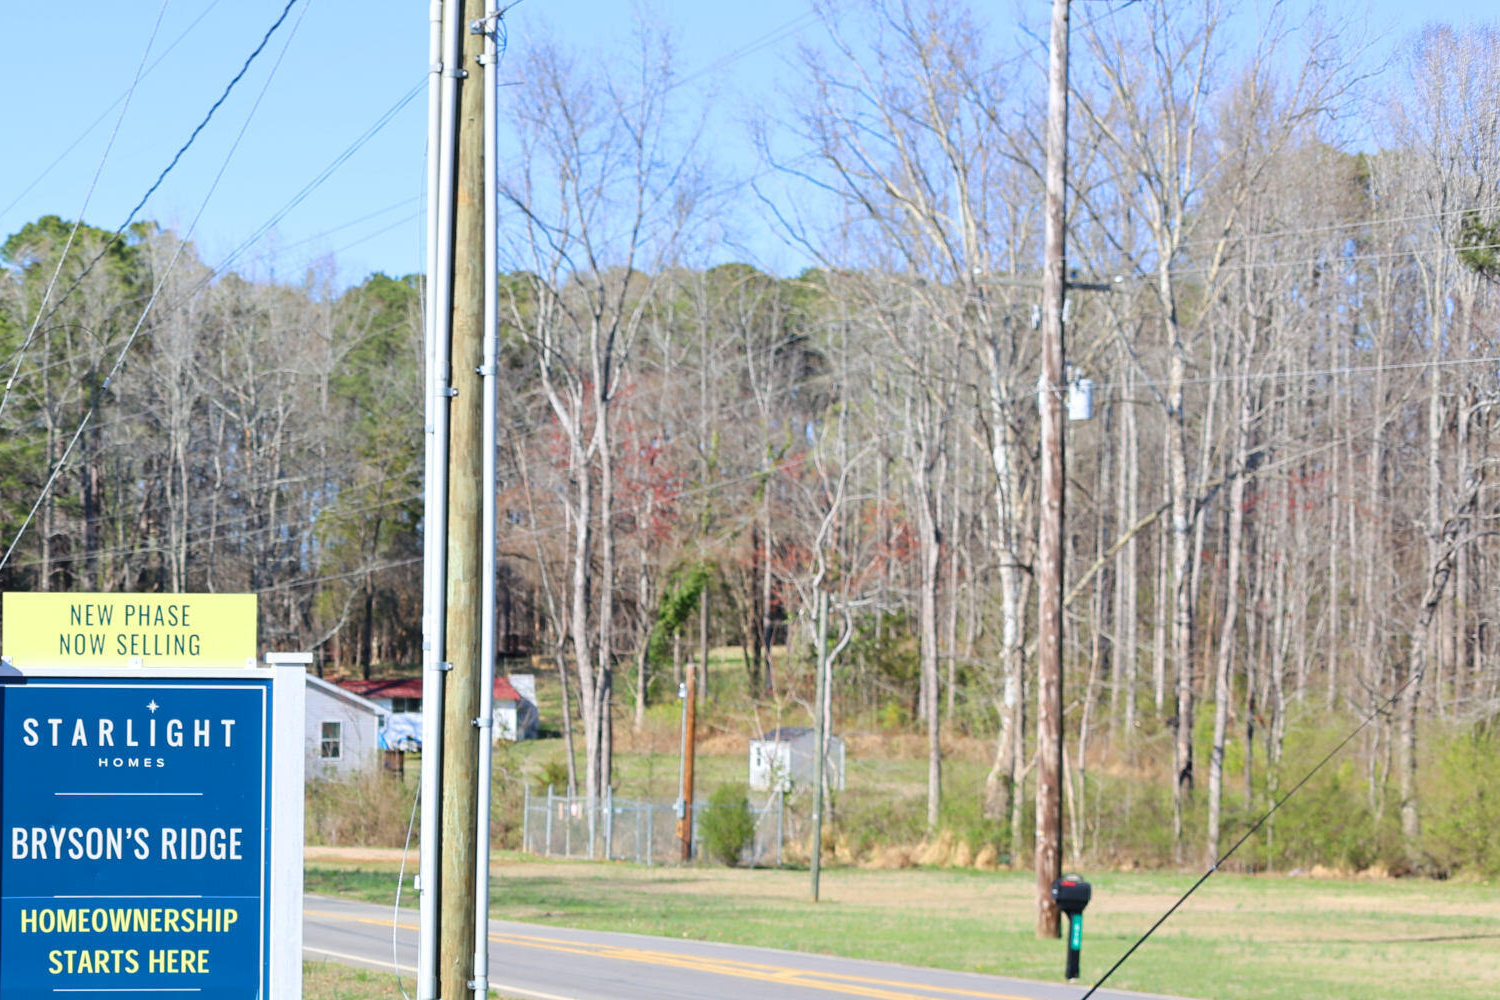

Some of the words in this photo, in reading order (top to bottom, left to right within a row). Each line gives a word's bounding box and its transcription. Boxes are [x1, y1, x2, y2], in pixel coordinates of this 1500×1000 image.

[70, 604, 114, 627] NEW
[125, 604, 191, 627] PHASE
[59, 633, 106, 656] NOW
[116, 633, 200, 656] SELLING
[23, 718, 236, 748] STARLIGHT
[98, 757, 166, 768] HOMES
[11, 826, 150, 860] BRYSON'S
[161, 827, 243, 861] RIDGE
[20, 907, 238, 934] HOMEOWNERSHIP
[48, 949, 140, 975] STARTS
[148, 949, 210, 974] HERE
